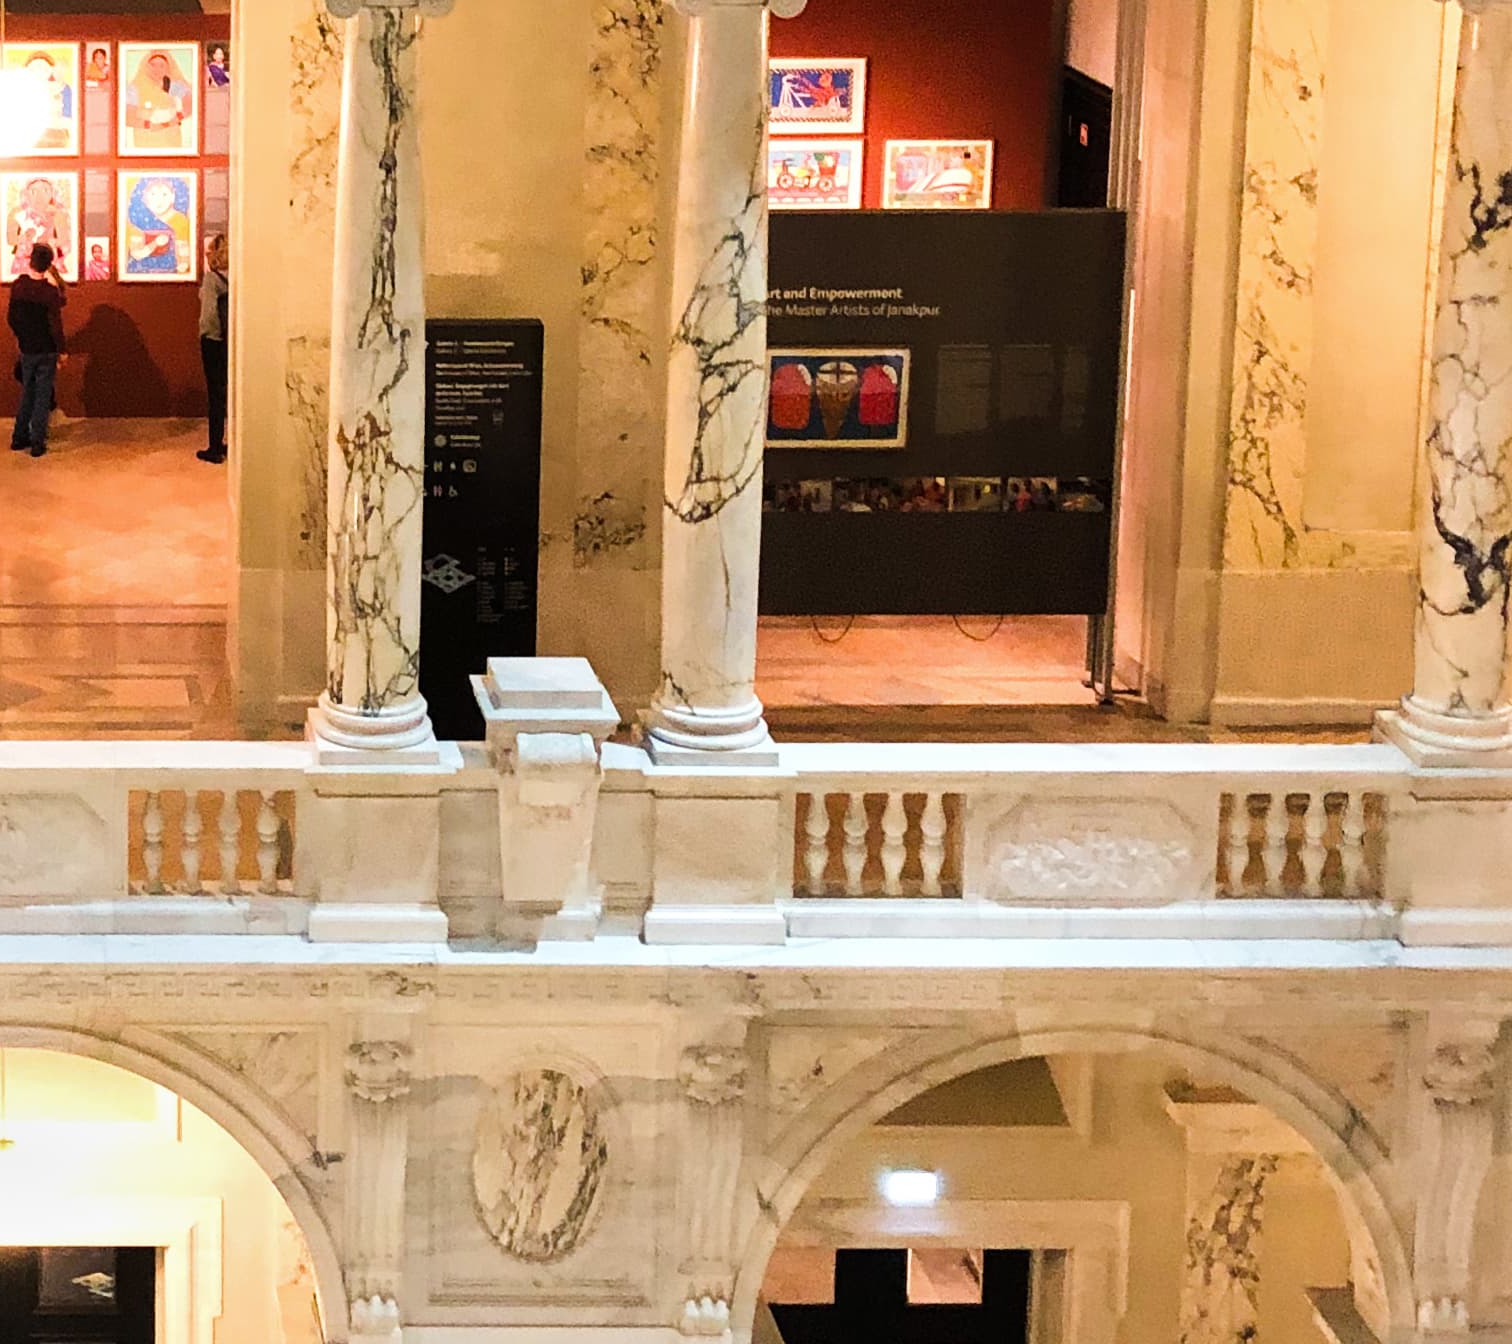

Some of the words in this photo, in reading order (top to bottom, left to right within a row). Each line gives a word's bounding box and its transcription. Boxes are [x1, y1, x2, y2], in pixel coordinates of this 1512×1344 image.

[767, 287, 782, 300] rt
[784, 287, 806, 300] and
[810, 287, 904, 302] Empowerment
[767, 303, 782, 316] he
[786, 303, 826, 316] Master
[830, 303, 870, 316] Artists
[872, 303, 885, 316] of
[886, 303, 941, 318] Janakpur
